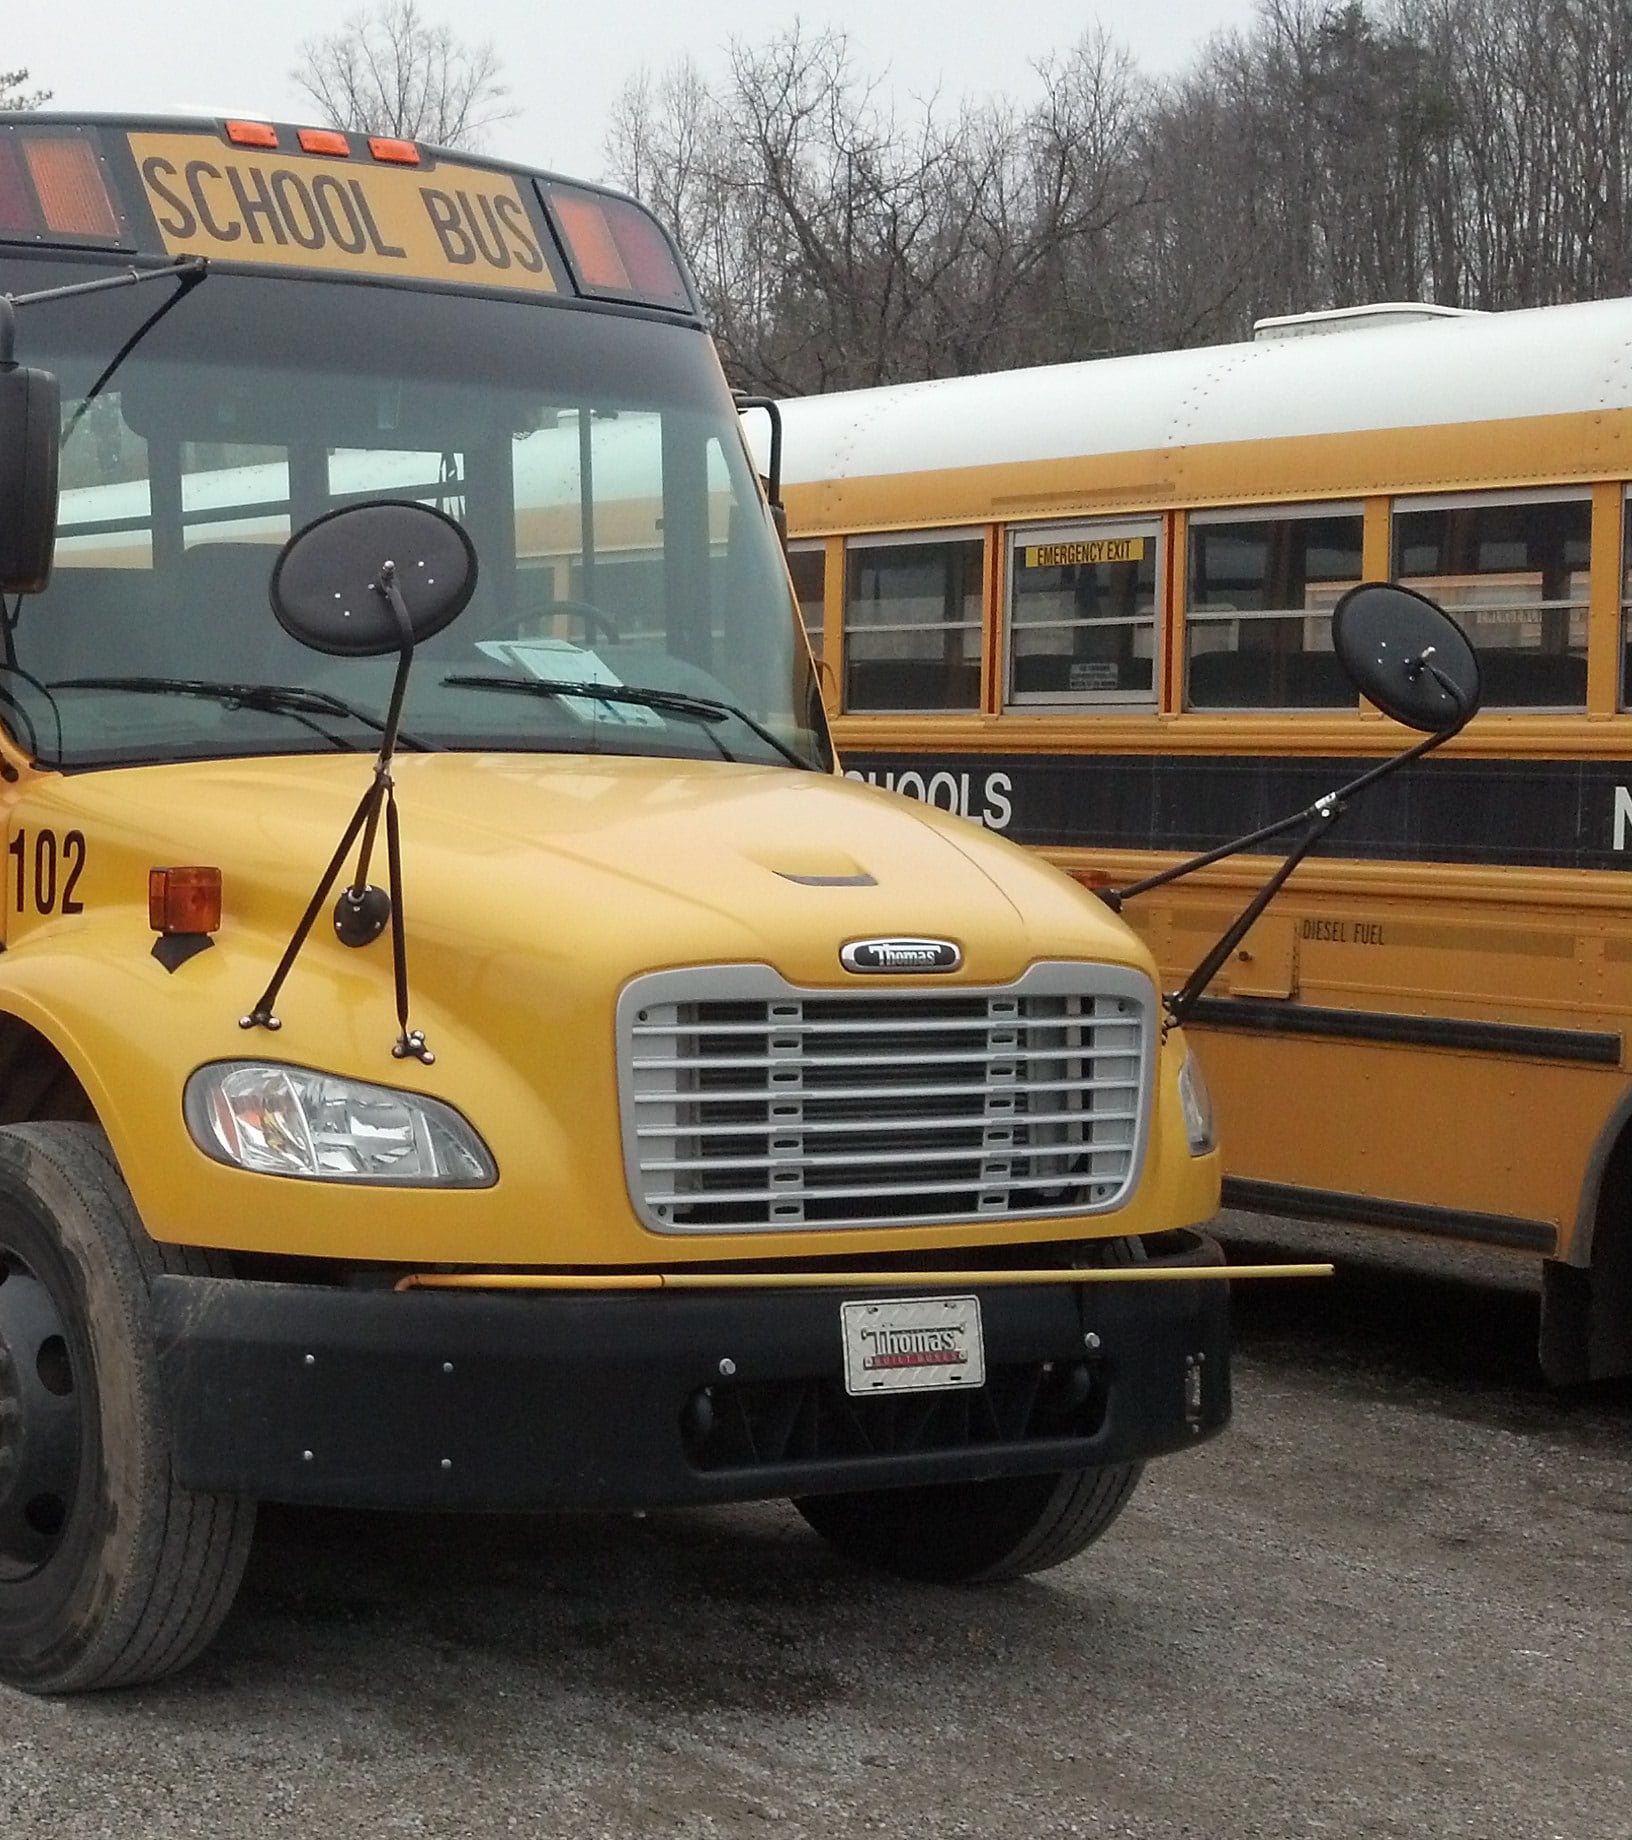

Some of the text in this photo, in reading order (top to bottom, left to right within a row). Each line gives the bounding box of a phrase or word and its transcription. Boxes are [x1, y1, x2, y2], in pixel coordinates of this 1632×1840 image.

[142, 156, 544, 273] SCHOOL BUS
[1037, 540, 1132, 567] EMERGENCY EXIT
[9, 828, 87, 915] 102
[1302, 919, 1385, 946] DIESEL FUEL
[868, 943, 942, 967] Thomas
[861, 1323, 966, 1356] Thomas
